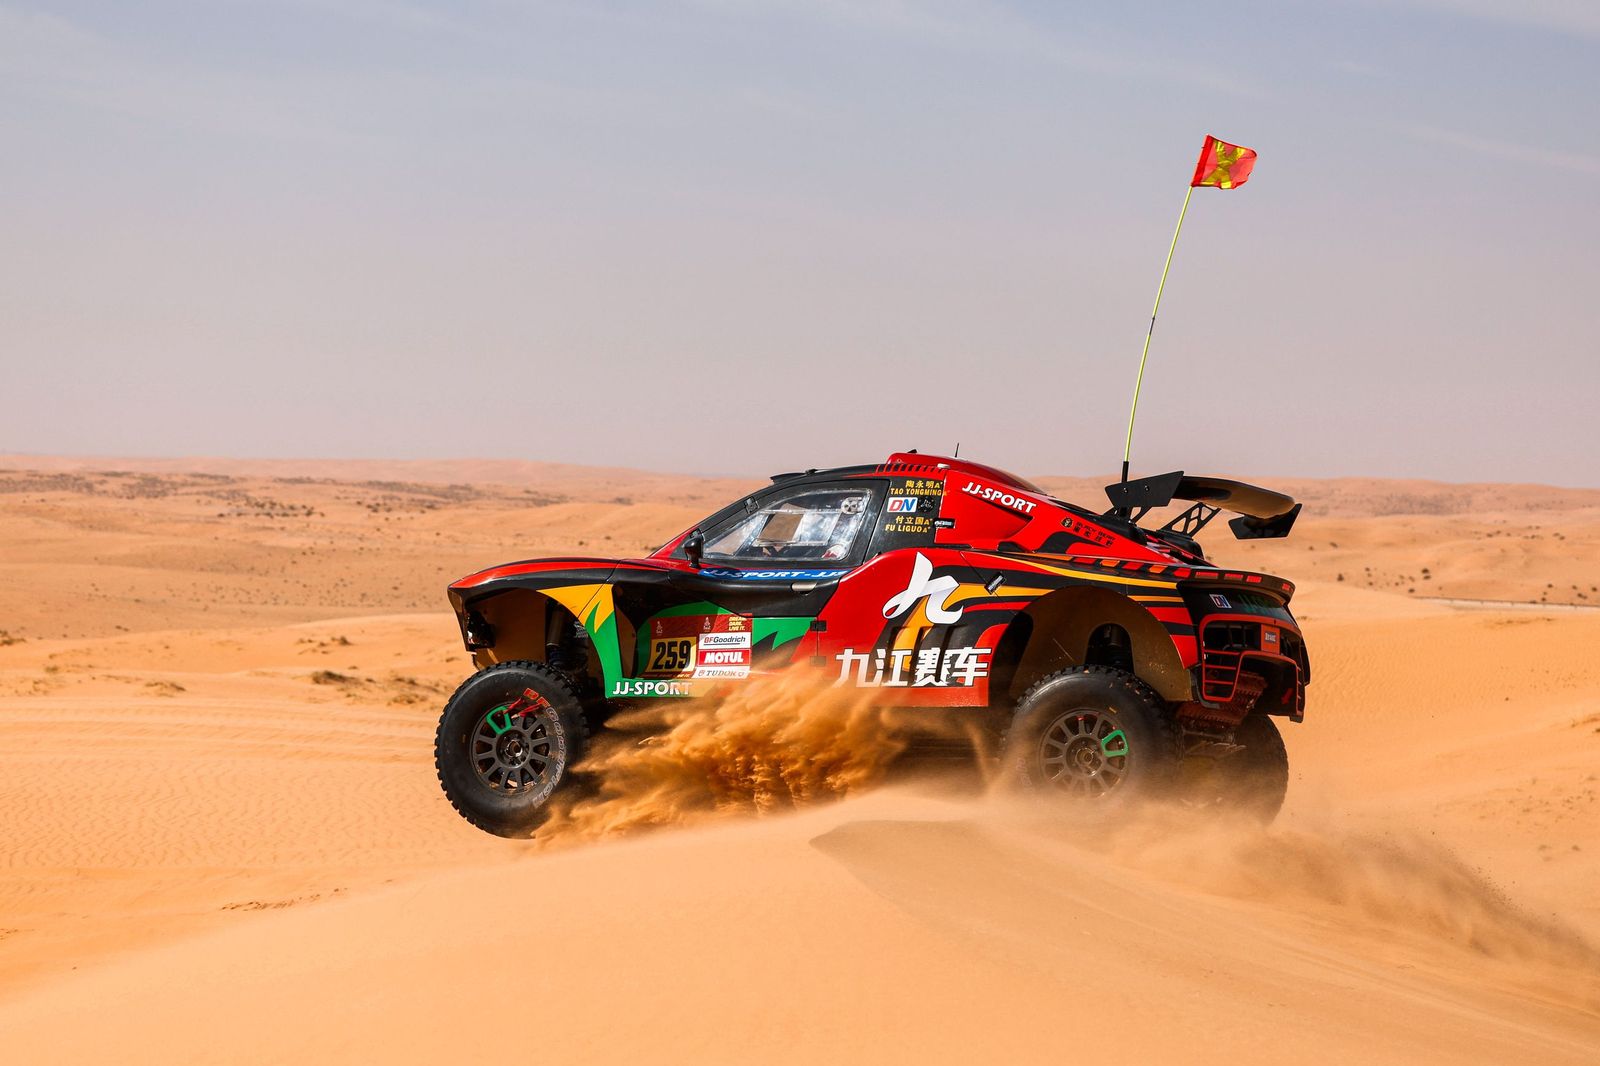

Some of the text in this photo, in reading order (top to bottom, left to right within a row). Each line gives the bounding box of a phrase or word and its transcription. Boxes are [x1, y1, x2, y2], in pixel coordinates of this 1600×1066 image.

[906, 488, 942, 496] YONGMING
[962, 482, 1036, 513] JJ-SPORT
[889, 498, 916, 512] DN
[884, 524, 896, 532] FU
[898, 525, 922, 533] LIGUO
[652, 640, 691, 670] 259
[704, 651, 744, 664] MOTUL
[832, 647, 991, 688] 九江赛车
[612, 681, 692, 695] JJ-SPORT
